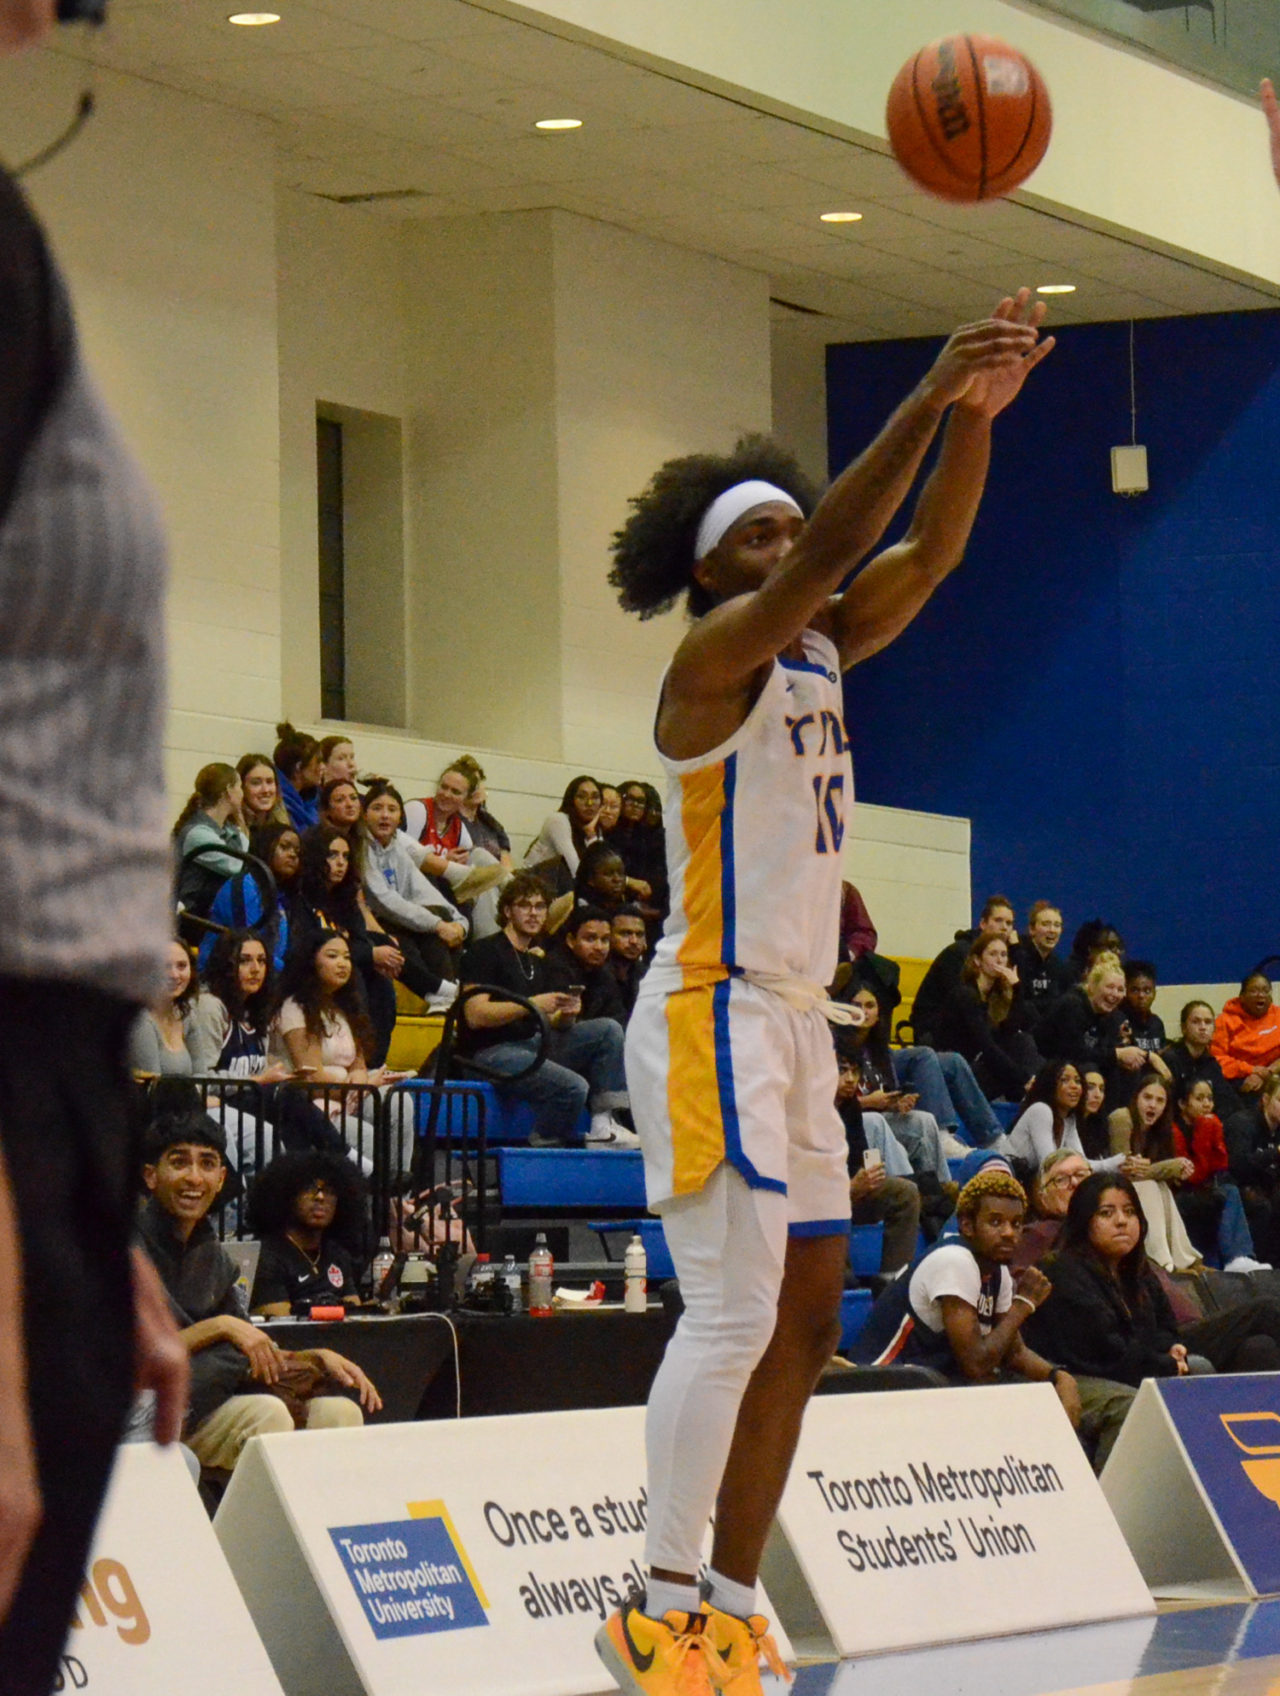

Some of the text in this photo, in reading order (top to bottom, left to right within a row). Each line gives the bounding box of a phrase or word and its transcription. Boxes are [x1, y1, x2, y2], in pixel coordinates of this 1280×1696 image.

[807, 1454, 1064, 1514] Toronto Metropolitan
[483, 1501, 569, 1547] Once
[570, 1505, 594, 1539] a
[836, 1515, 1037, 1573] Students' Union
[339, 1537, 408, 1564] Toronto
[354, 1560, 463, 1596] Metropolitan
[519, 1571, 622, 1621] always
[368, 1592, 455, 1625] University
